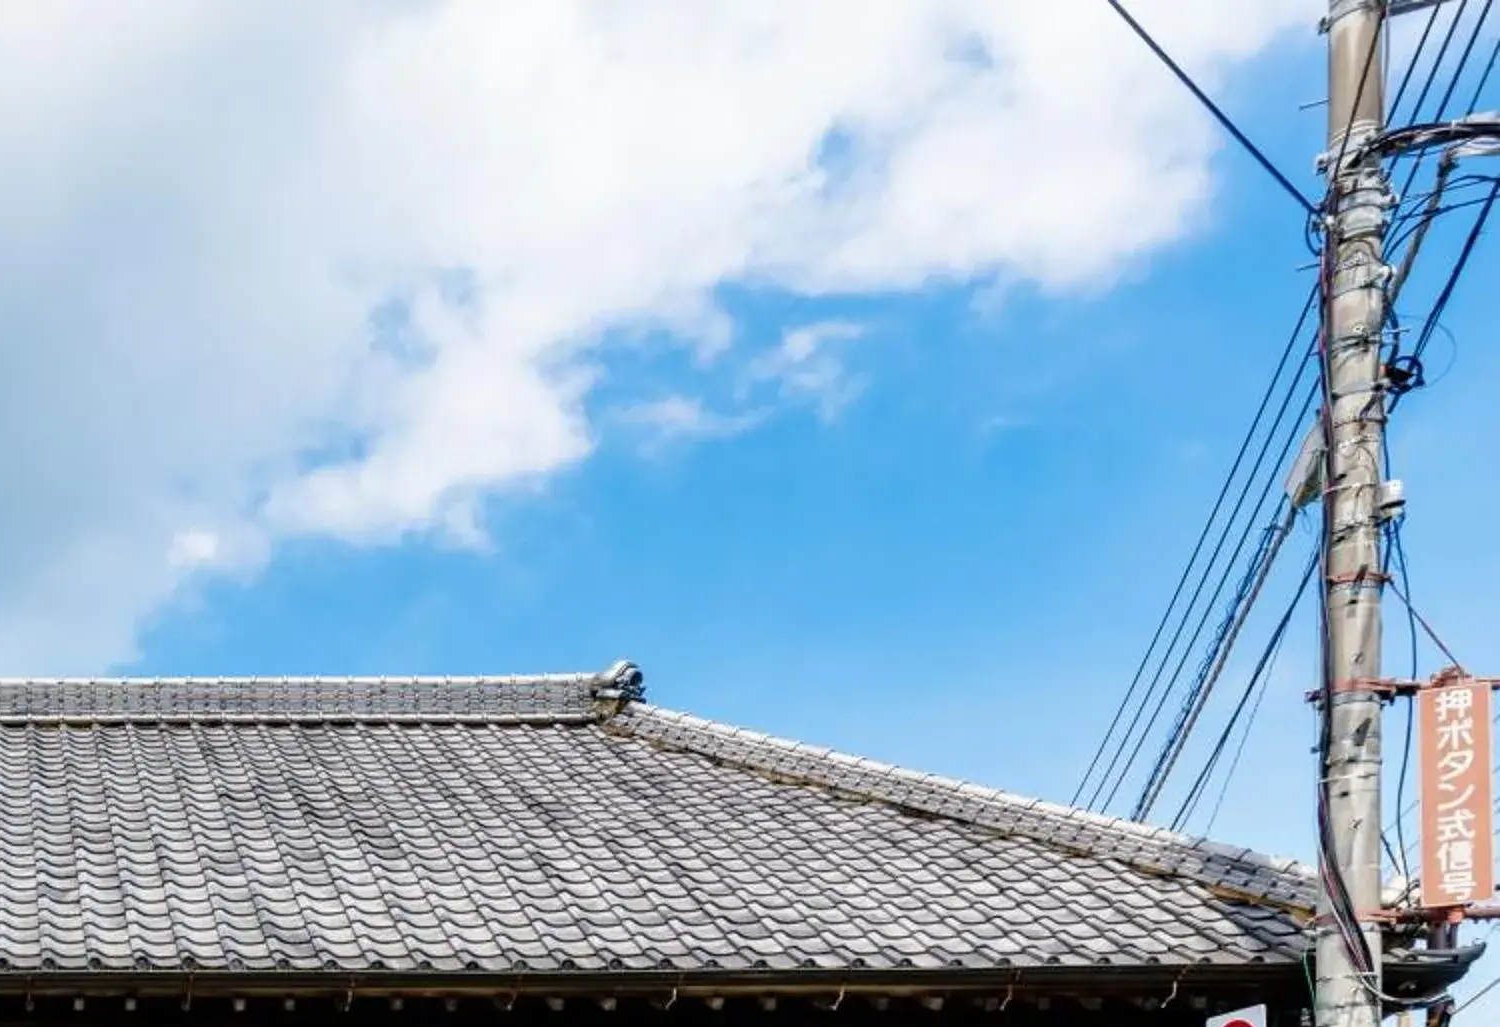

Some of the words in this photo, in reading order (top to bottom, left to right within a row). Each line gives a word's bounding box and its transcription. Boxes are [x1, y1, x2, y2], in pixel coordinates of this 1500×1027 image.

[1434, 689, 1476, 900] 押ボタン式信号
